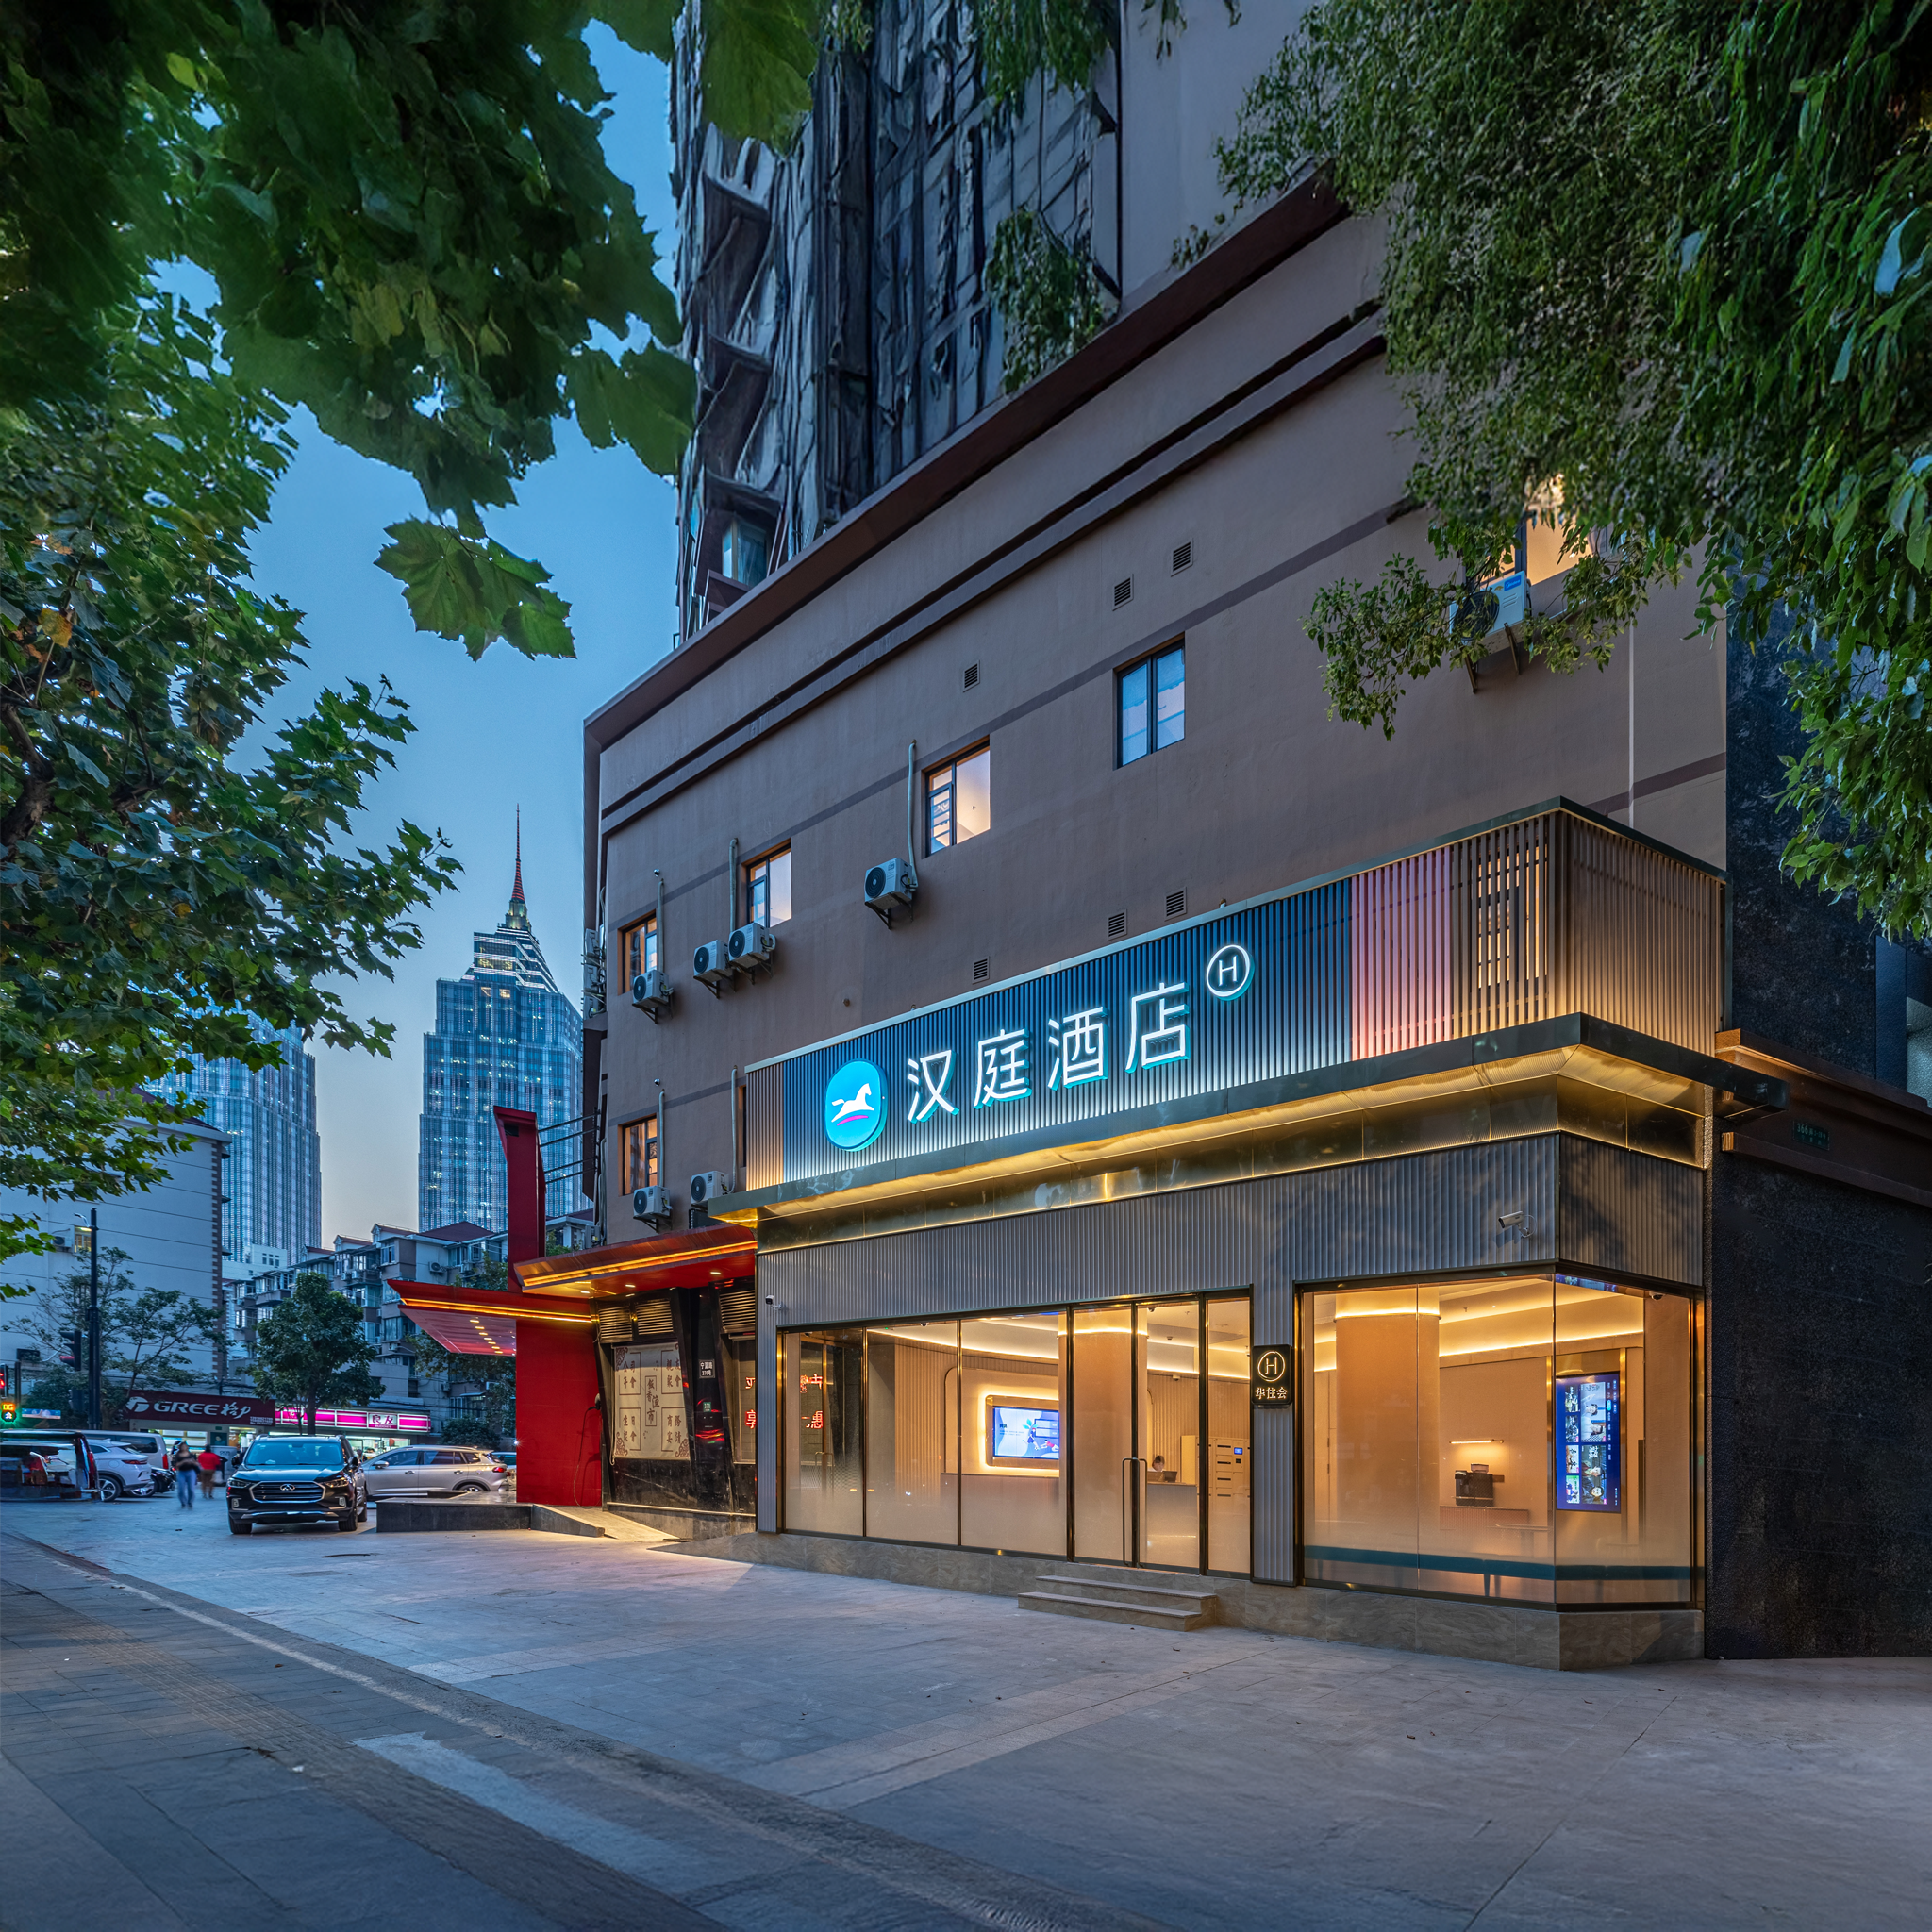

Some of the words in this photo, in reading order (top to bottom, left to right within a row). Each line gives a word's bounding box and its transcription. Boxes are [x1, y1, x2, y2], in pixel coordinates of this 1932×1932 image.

[907, 982, 1191, 1124] 汉庭酒店
[1255, 1386, 1288, 1400] 华住会
[153, 1401, 220, 1415] GREE
[372, 1414, 393, 1424] 良友
